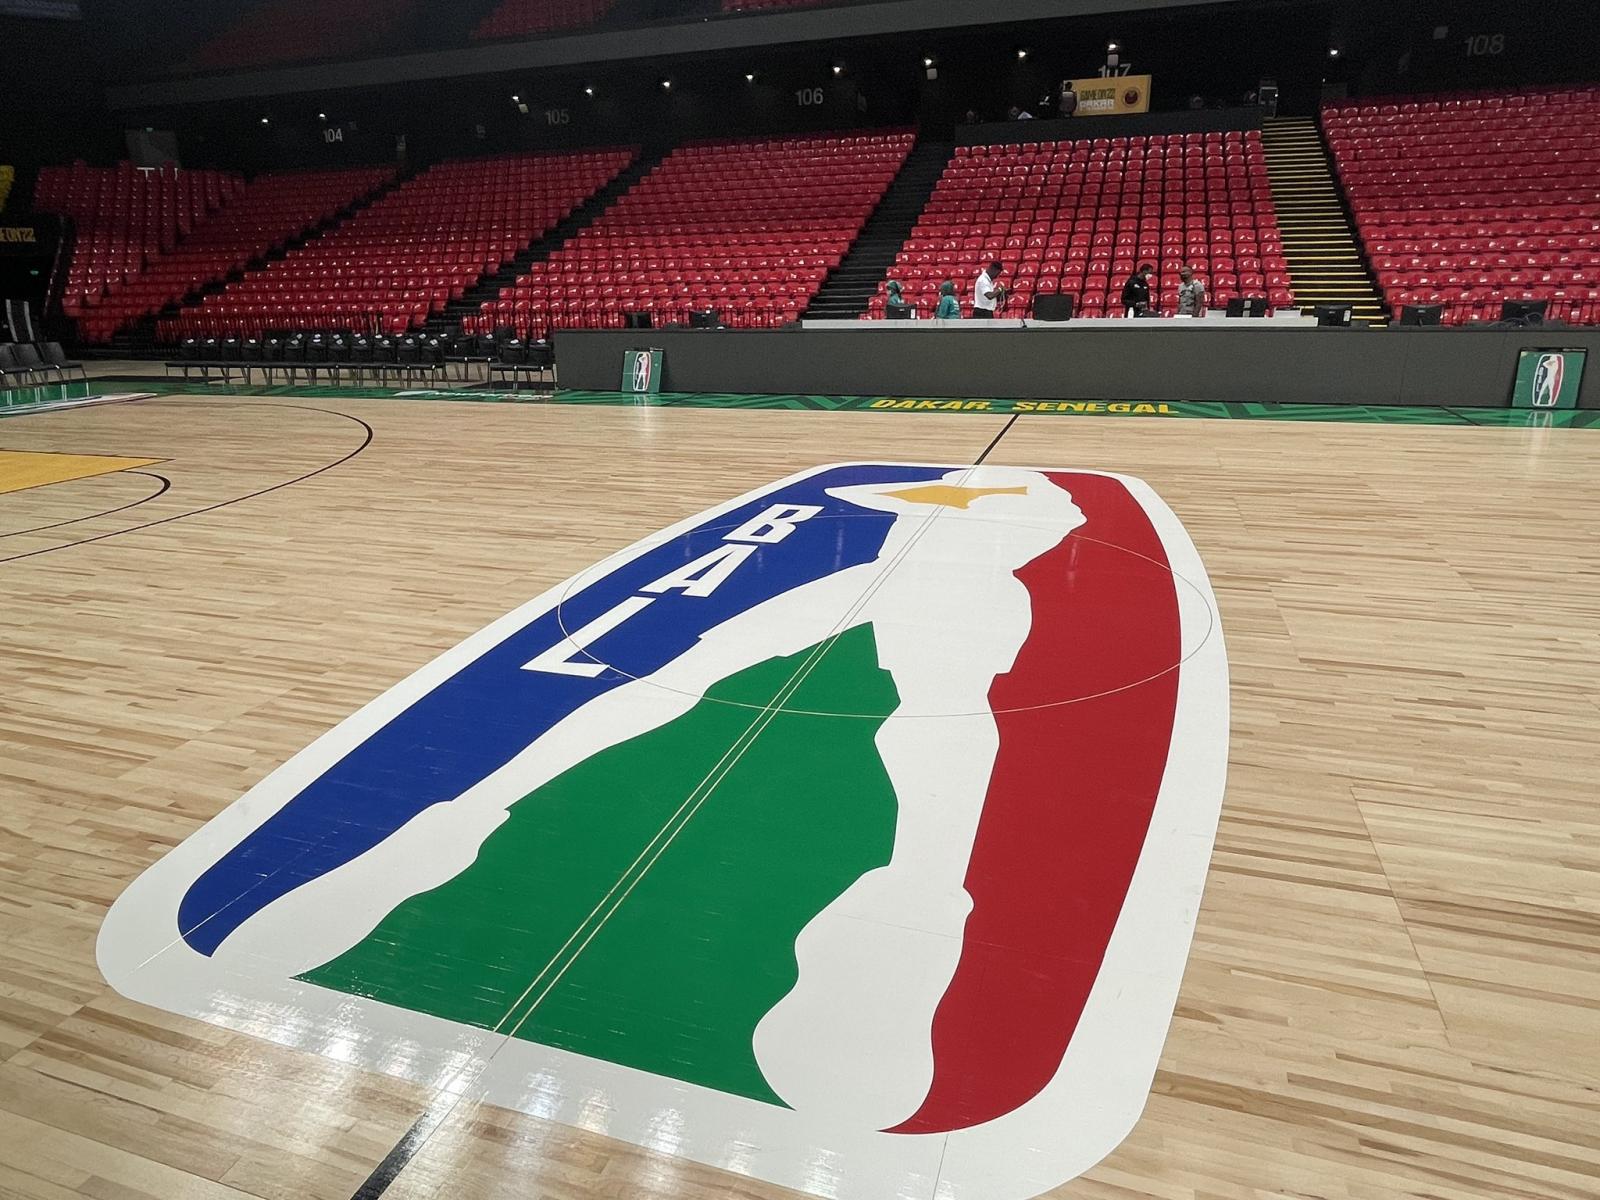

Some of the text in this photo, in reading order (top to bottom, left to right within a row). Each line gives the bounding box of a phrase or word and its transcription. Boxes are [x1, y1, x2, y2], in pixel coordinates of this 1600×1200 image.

[1464, 33, 1505, 57] 108
[795, 87, 823, 106] 106
[545, 109, 570, 125] 105
[323, 128, 343, 143] 104
[1012, 401, 1179, 414] SENEGAL
[520, 503, 824, 678] BAL
